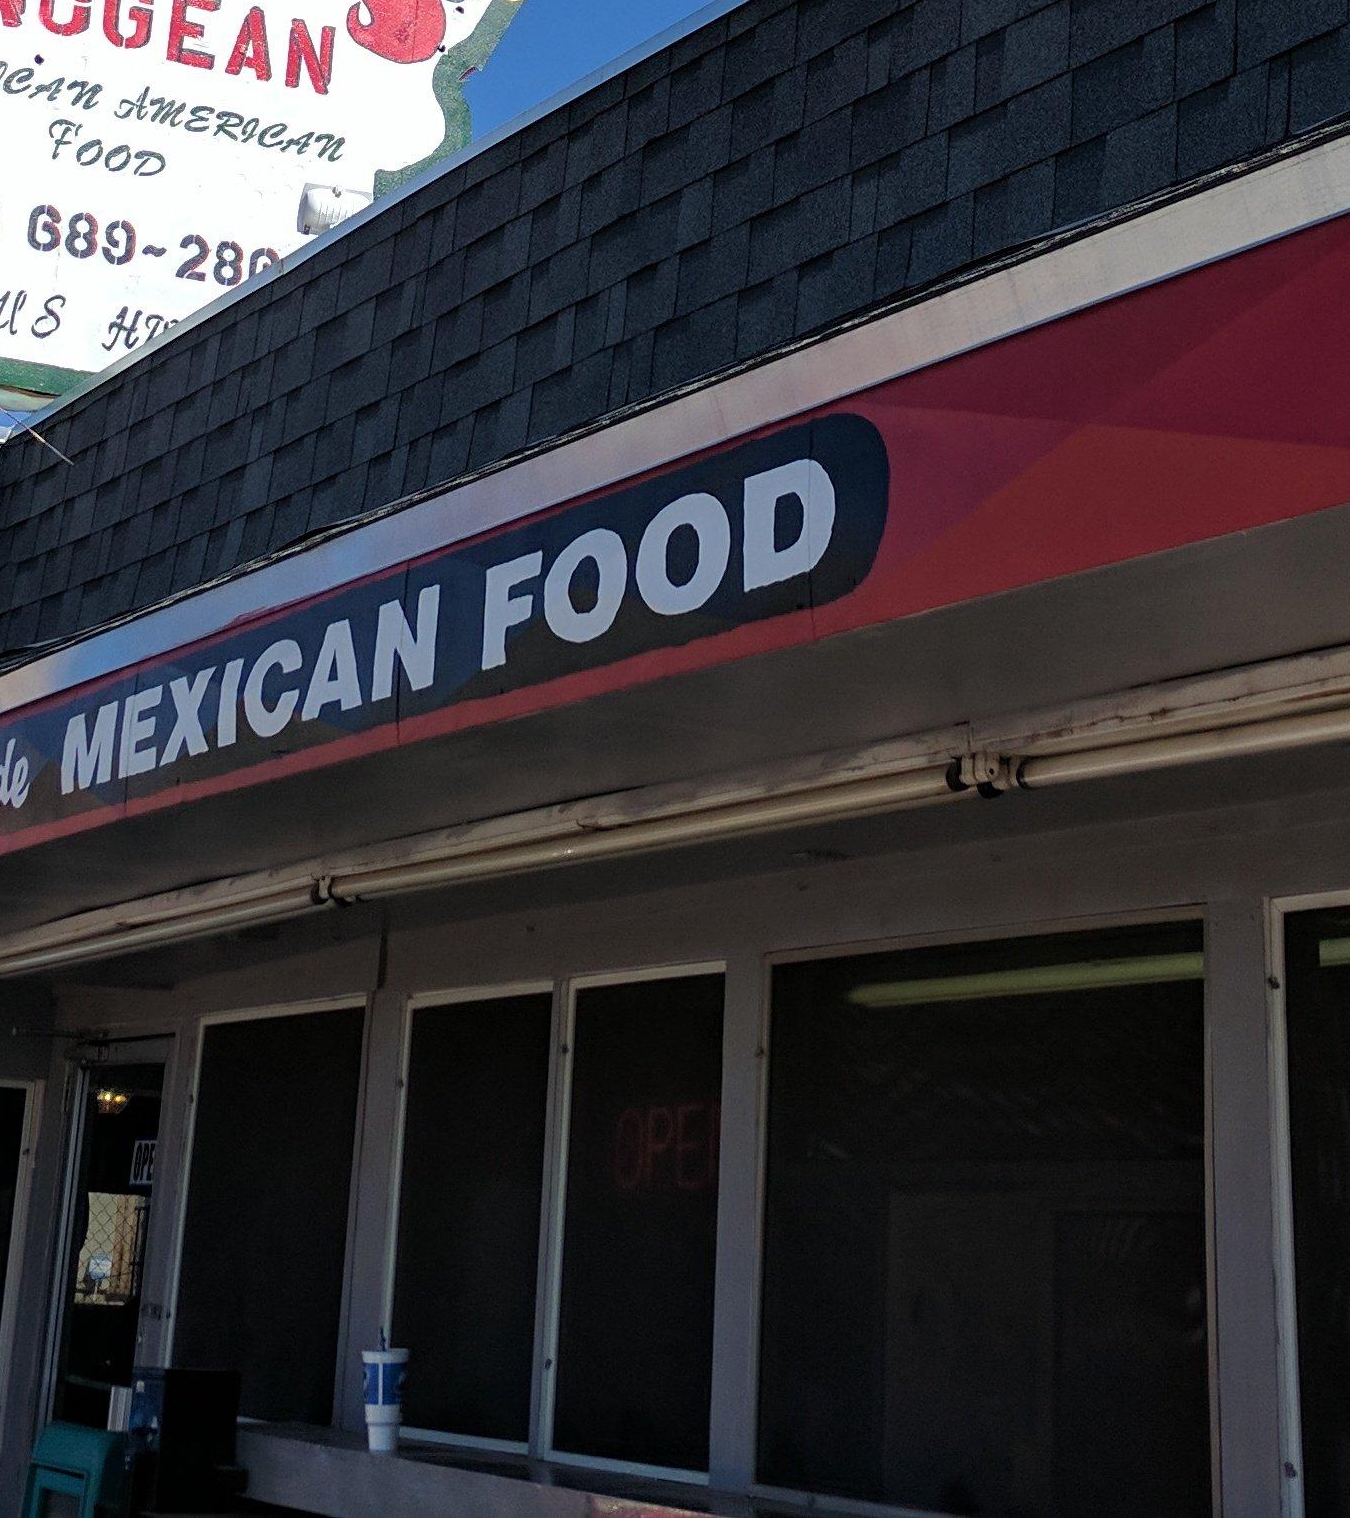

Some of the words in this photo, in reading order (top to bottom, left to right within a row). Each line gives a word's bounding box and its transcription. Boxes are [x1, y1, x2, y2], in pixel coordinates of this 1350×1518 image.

[48, 118, 167, 177] FOOD
[114, 86, 346, 163] AMERICAN
[61, 585, 440, 796] MEXICAN
[481, 459, 838, 670] FOOD
[133, 1142, 156, 1182] OPE
